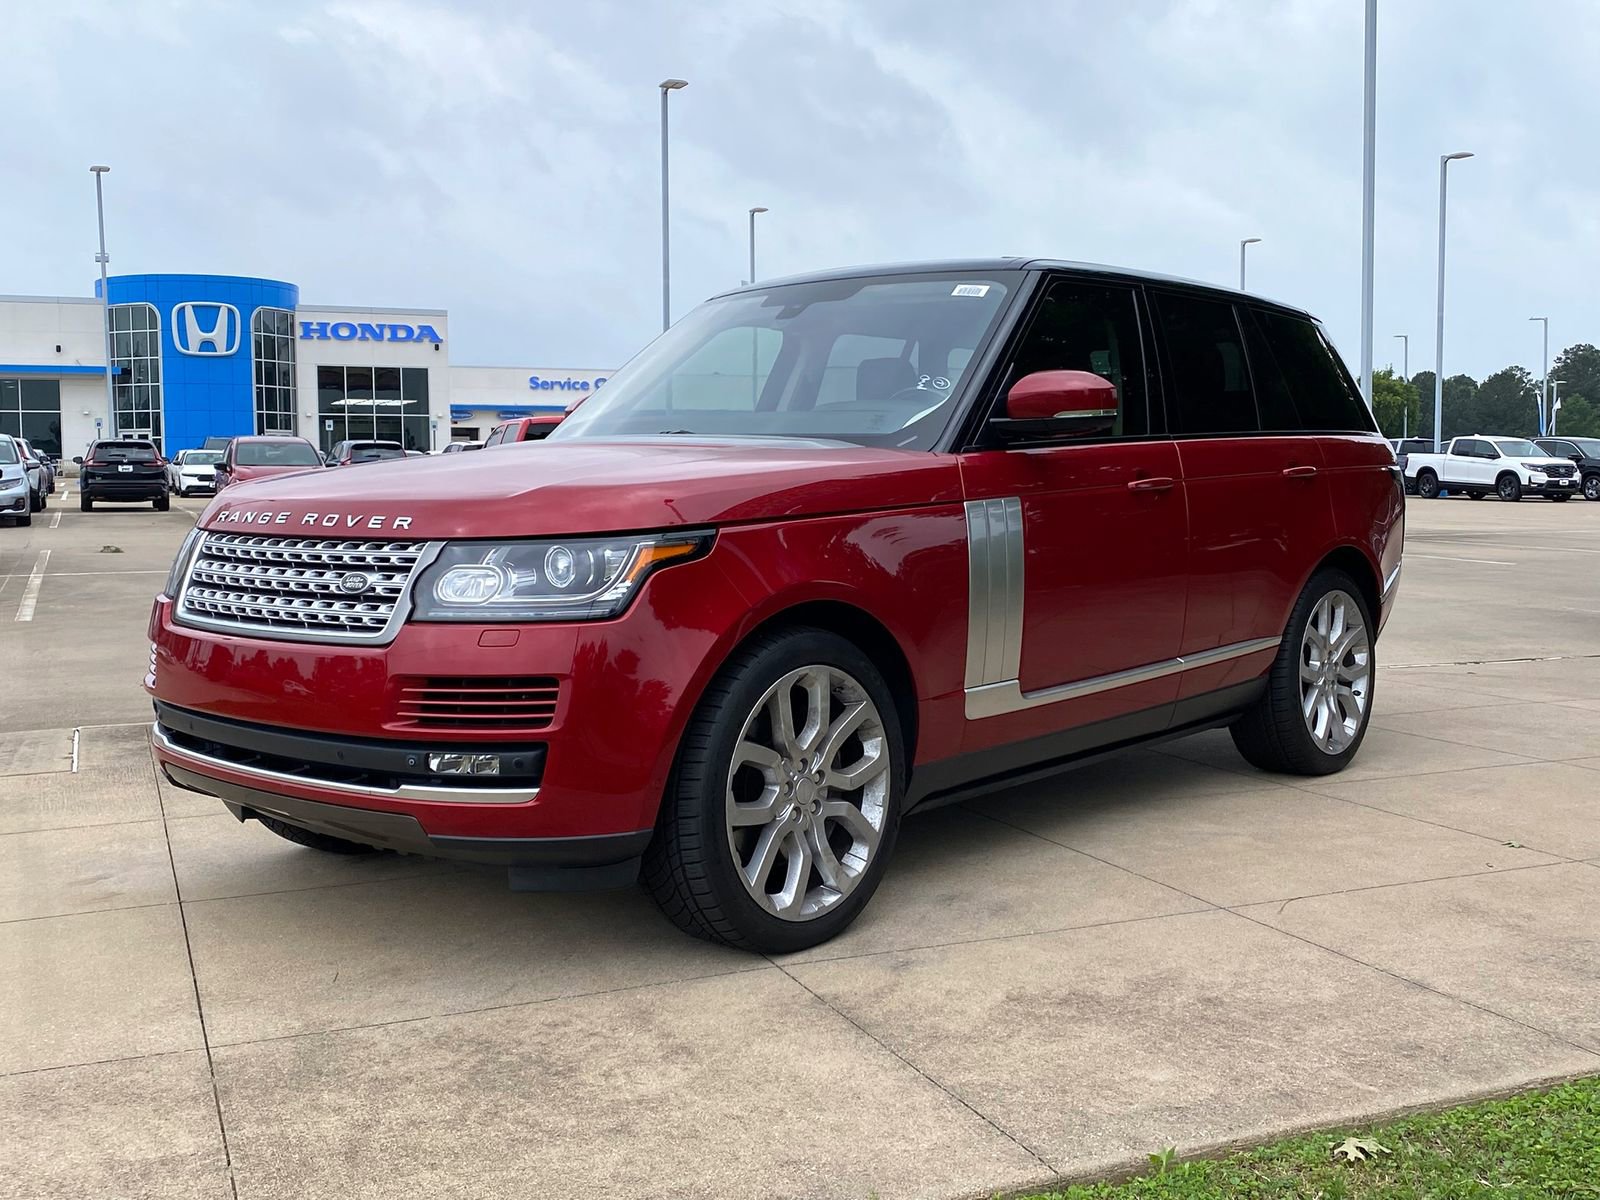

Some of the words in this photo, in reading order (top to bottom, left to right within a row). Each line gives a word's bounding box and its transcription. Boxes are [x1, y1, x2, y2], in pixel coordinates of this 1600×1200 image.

[299, 321, 444, 344] HONDA
[528, 376, 590, 391] Service
[216, 511, 291, 525] RANGE
[301, 513, 413, 530] ROVER
